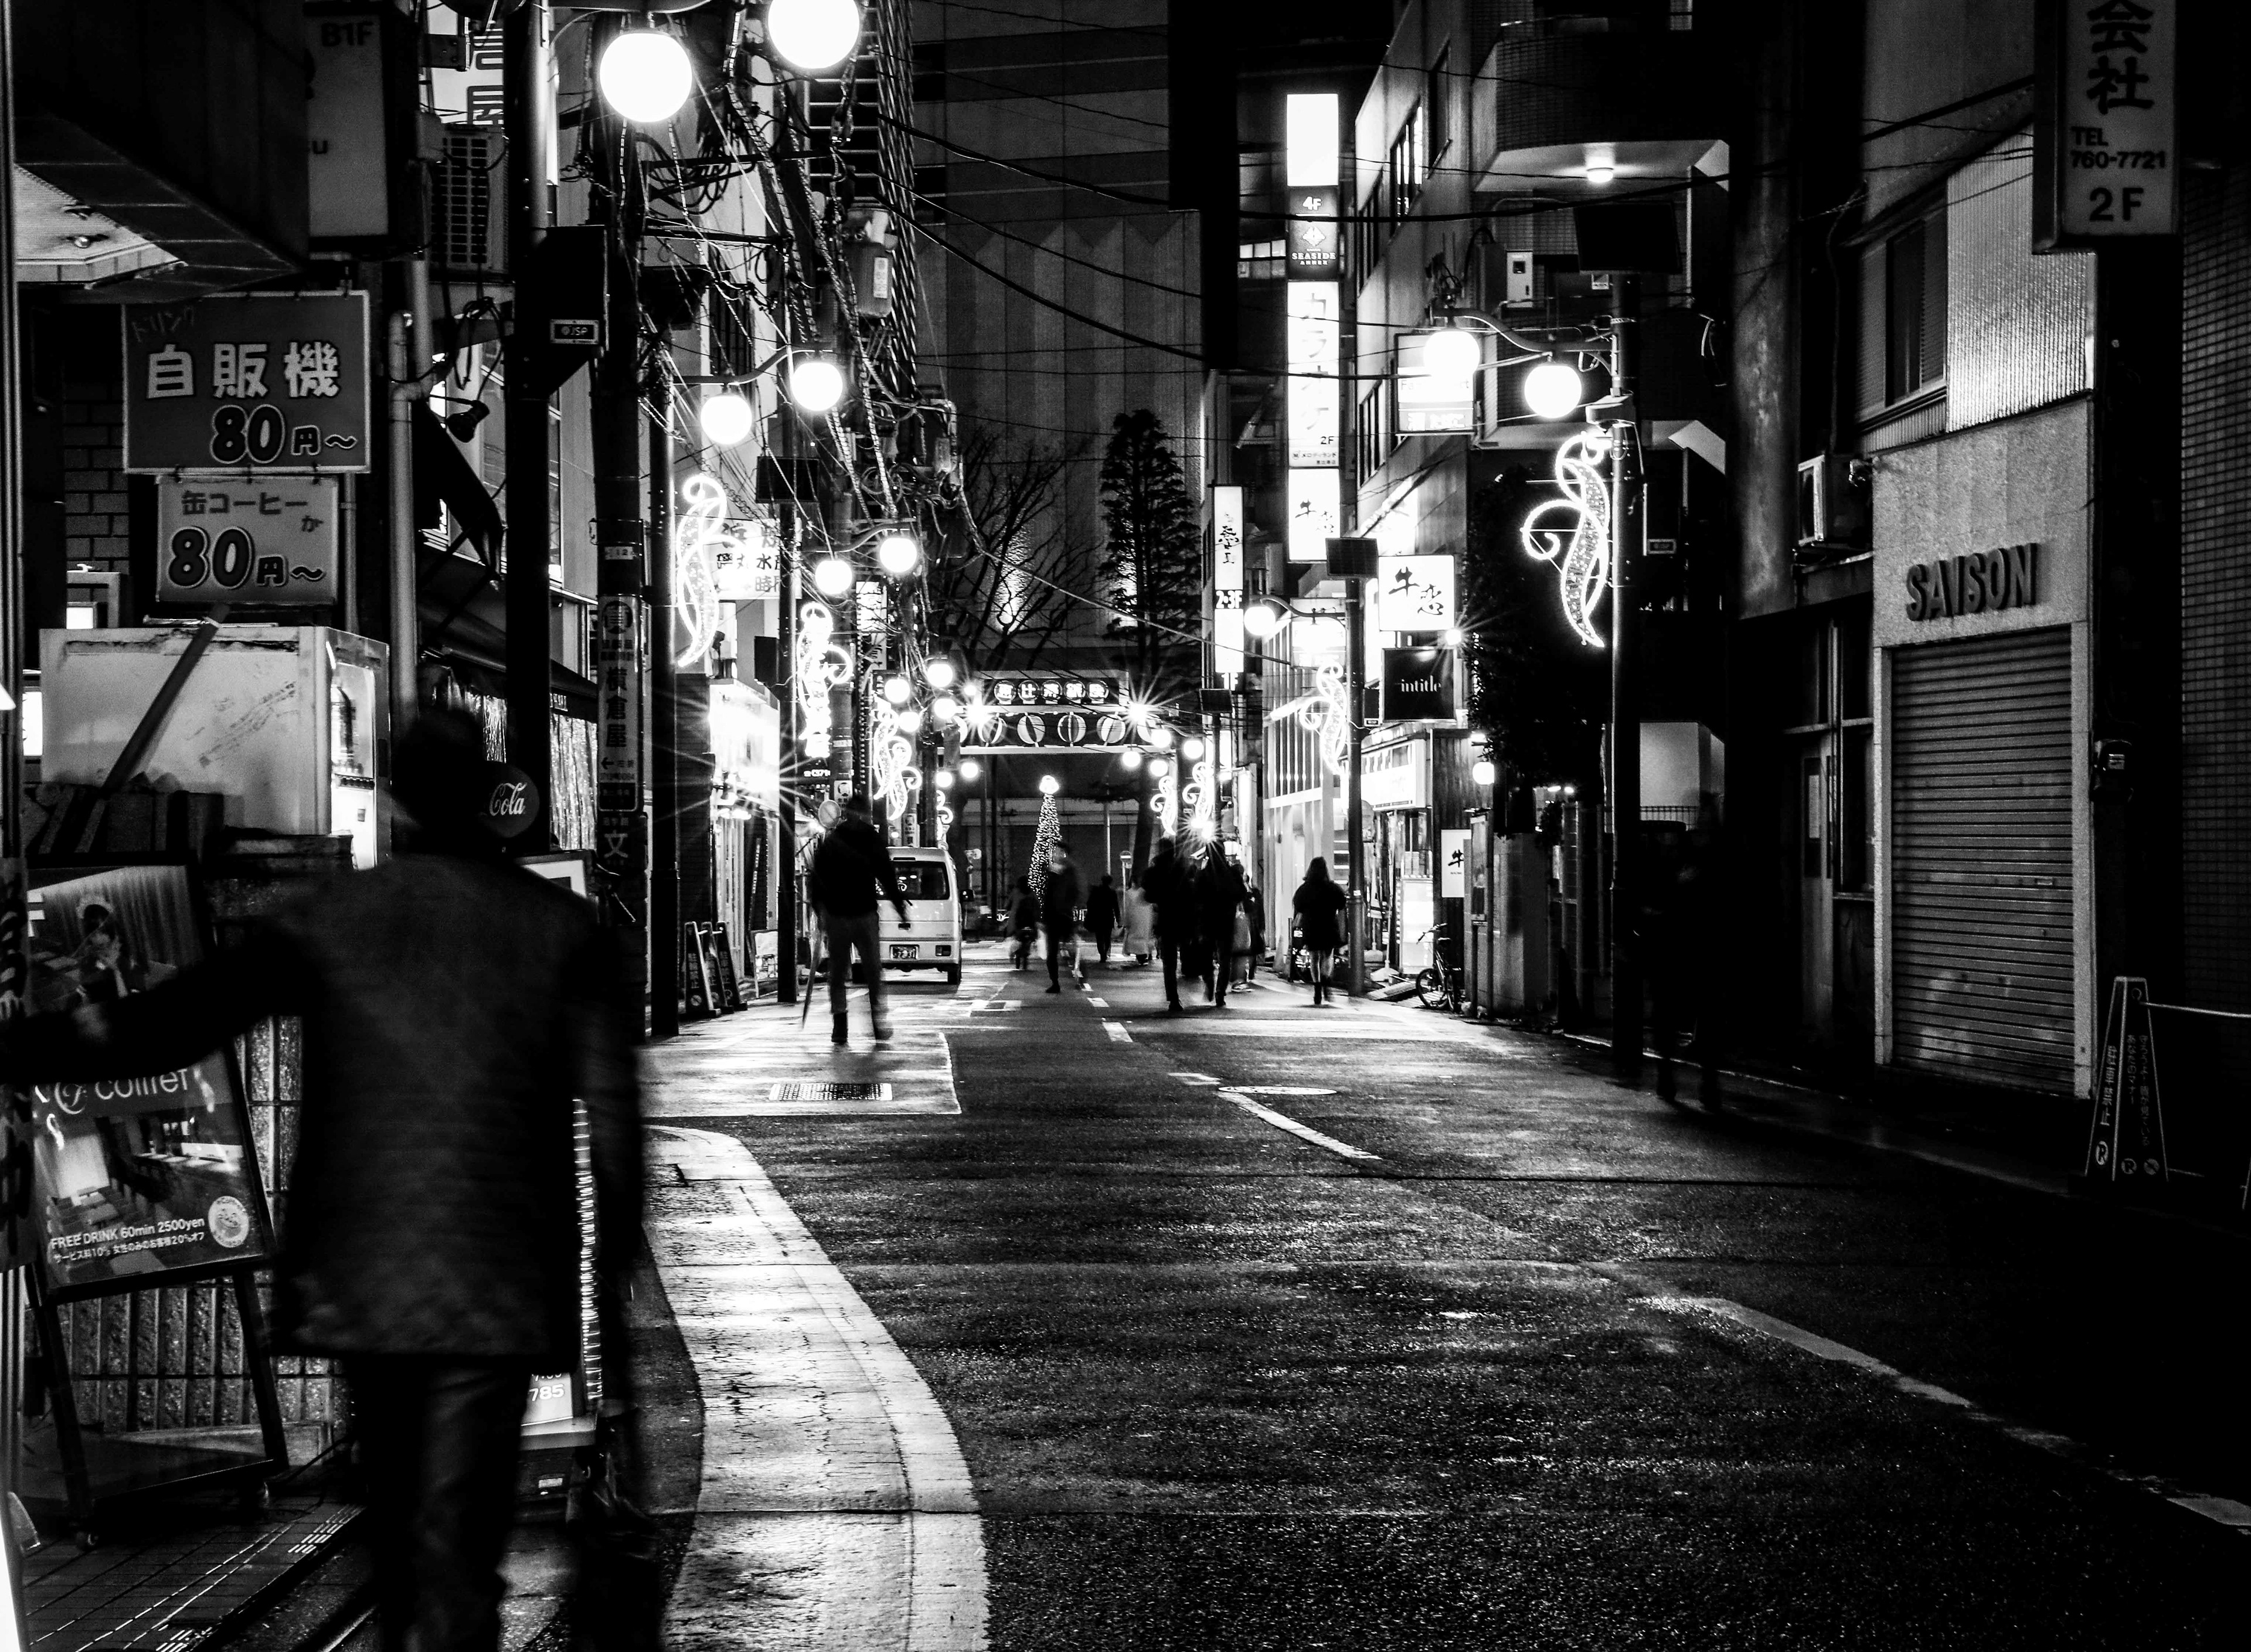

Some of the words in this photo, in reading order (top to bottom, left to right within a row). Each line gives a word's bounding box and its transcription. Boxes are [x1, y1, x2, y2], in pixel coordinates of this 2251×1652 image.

[321, 22, 372, 47] B1F
[2087, 0, 2155, 115] 会社
[2072, 128, 2109, 147] TEL
[2070, 151, 2166, 170] 760-7721
[1302, 196, 1322, 210] 4F
[2089, 187, 2145, 222] 2F
[146, 342, 339, 399] 自販機
[1320, 436, 1334, 445] 2F
[181, 490, 309, 515] 缶コーヒー
[1906, 542, 2041, 621] SAISON
[1221, 672, 1239, 691] 1F
[1400, 675, 1442, 692] intitle
[489, 782, 528, 817] Cola
[603, 829, 629, 858] 文
[50, 1233, 83, 1249] FREE
[83, 1228, 118, 1245] DRINK
[120, 1223, 156, 1239] 60min
[157, 1218, 205, 1233] 2500yen
